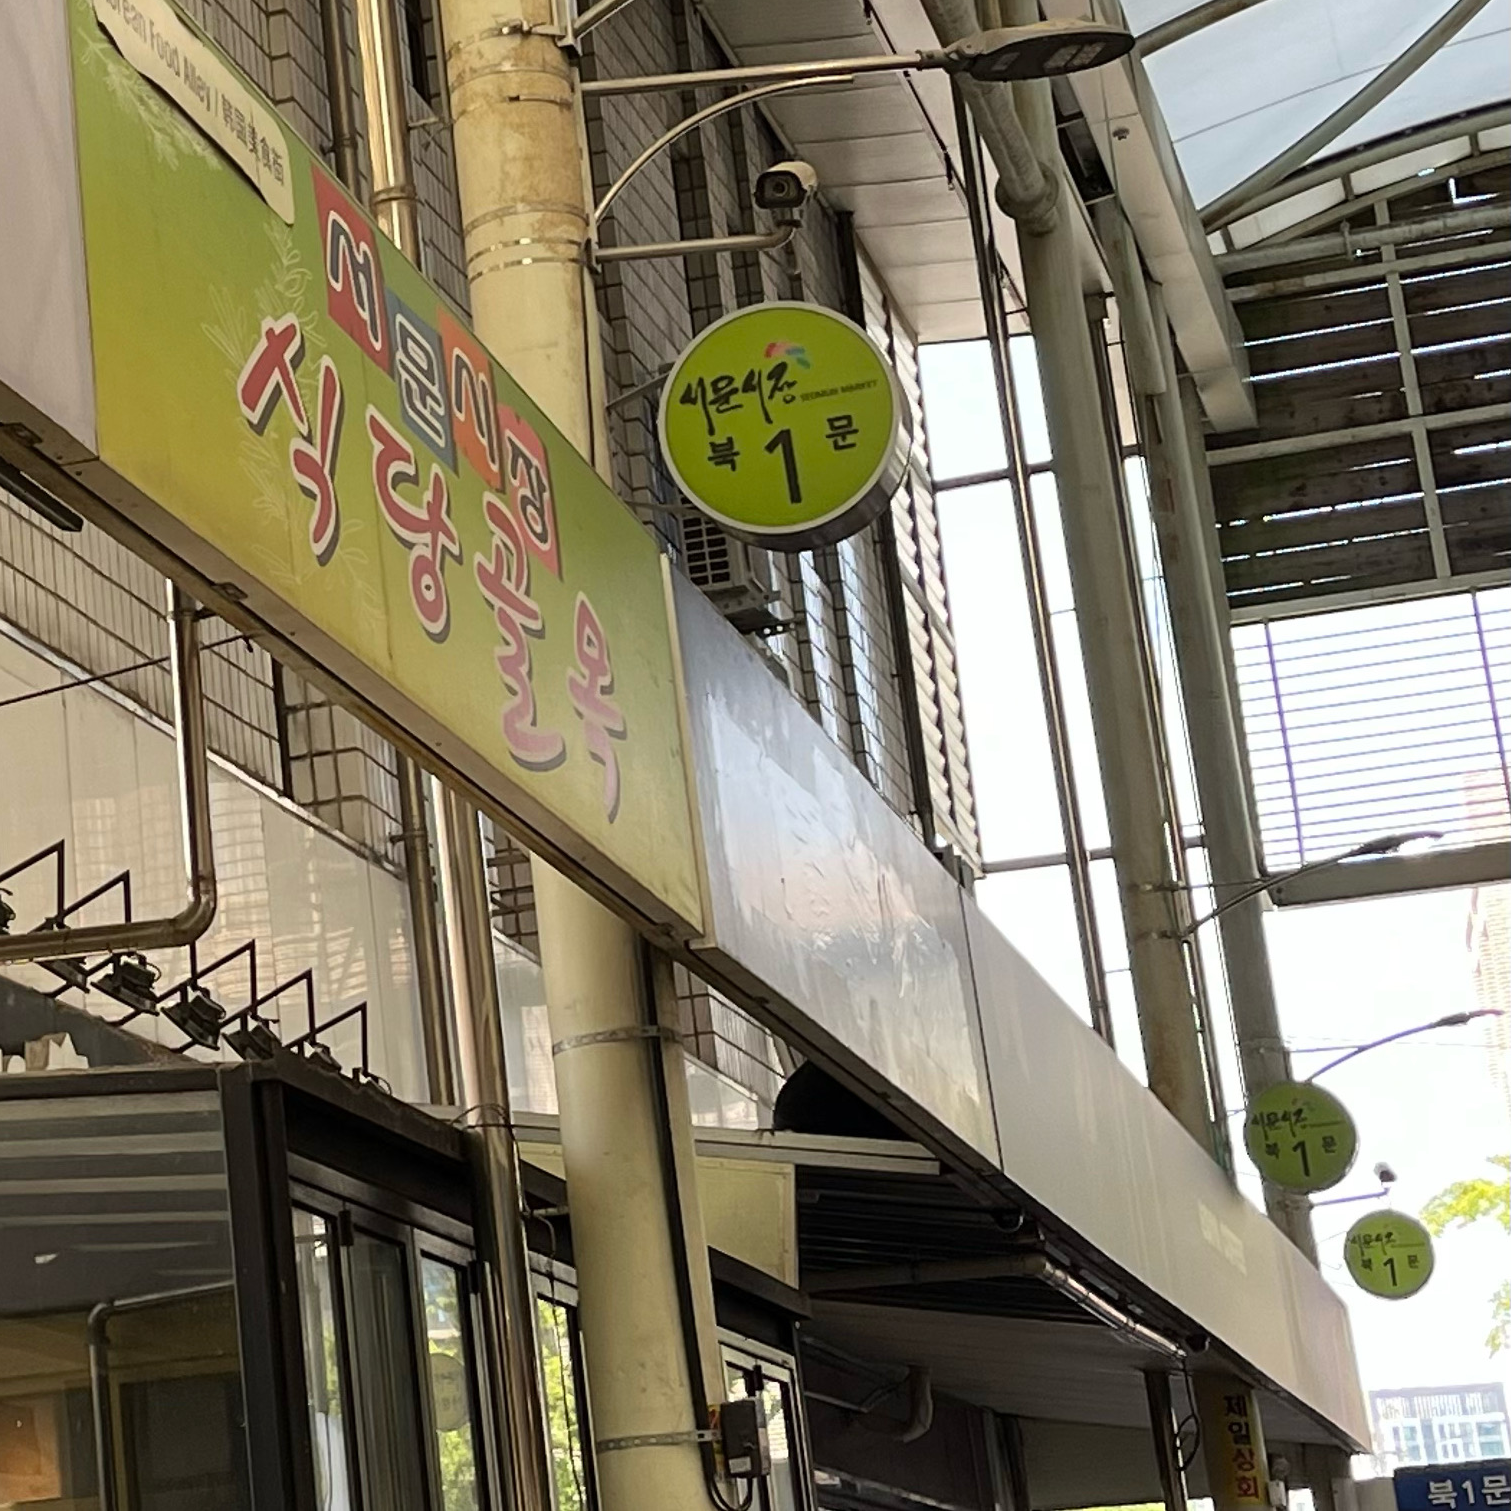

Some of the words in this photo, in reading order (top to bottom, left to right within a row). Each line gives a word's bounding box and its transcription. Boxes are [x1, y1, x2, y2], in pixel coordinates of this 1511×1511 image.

[150, 19, 181, 78] Food
[183, 53, 211, 112] Alley
[326, 208, 554, 552] 서문시장
[680, 361, 797, 436] 서문시장
[707, 436, 740, 472] 북
[764, 428, 802, 504] 1
[825, 414, 859, 451] 문
[239, 313, 626, 825] 식당골목
[1292, 1140, 1310, 1177] 1
[1383, 1257, 1398, 1286] 1
[1223, 1394, 1260, 1499] 제일상회
[1427, 1474, 1511, 1509] 북1문
